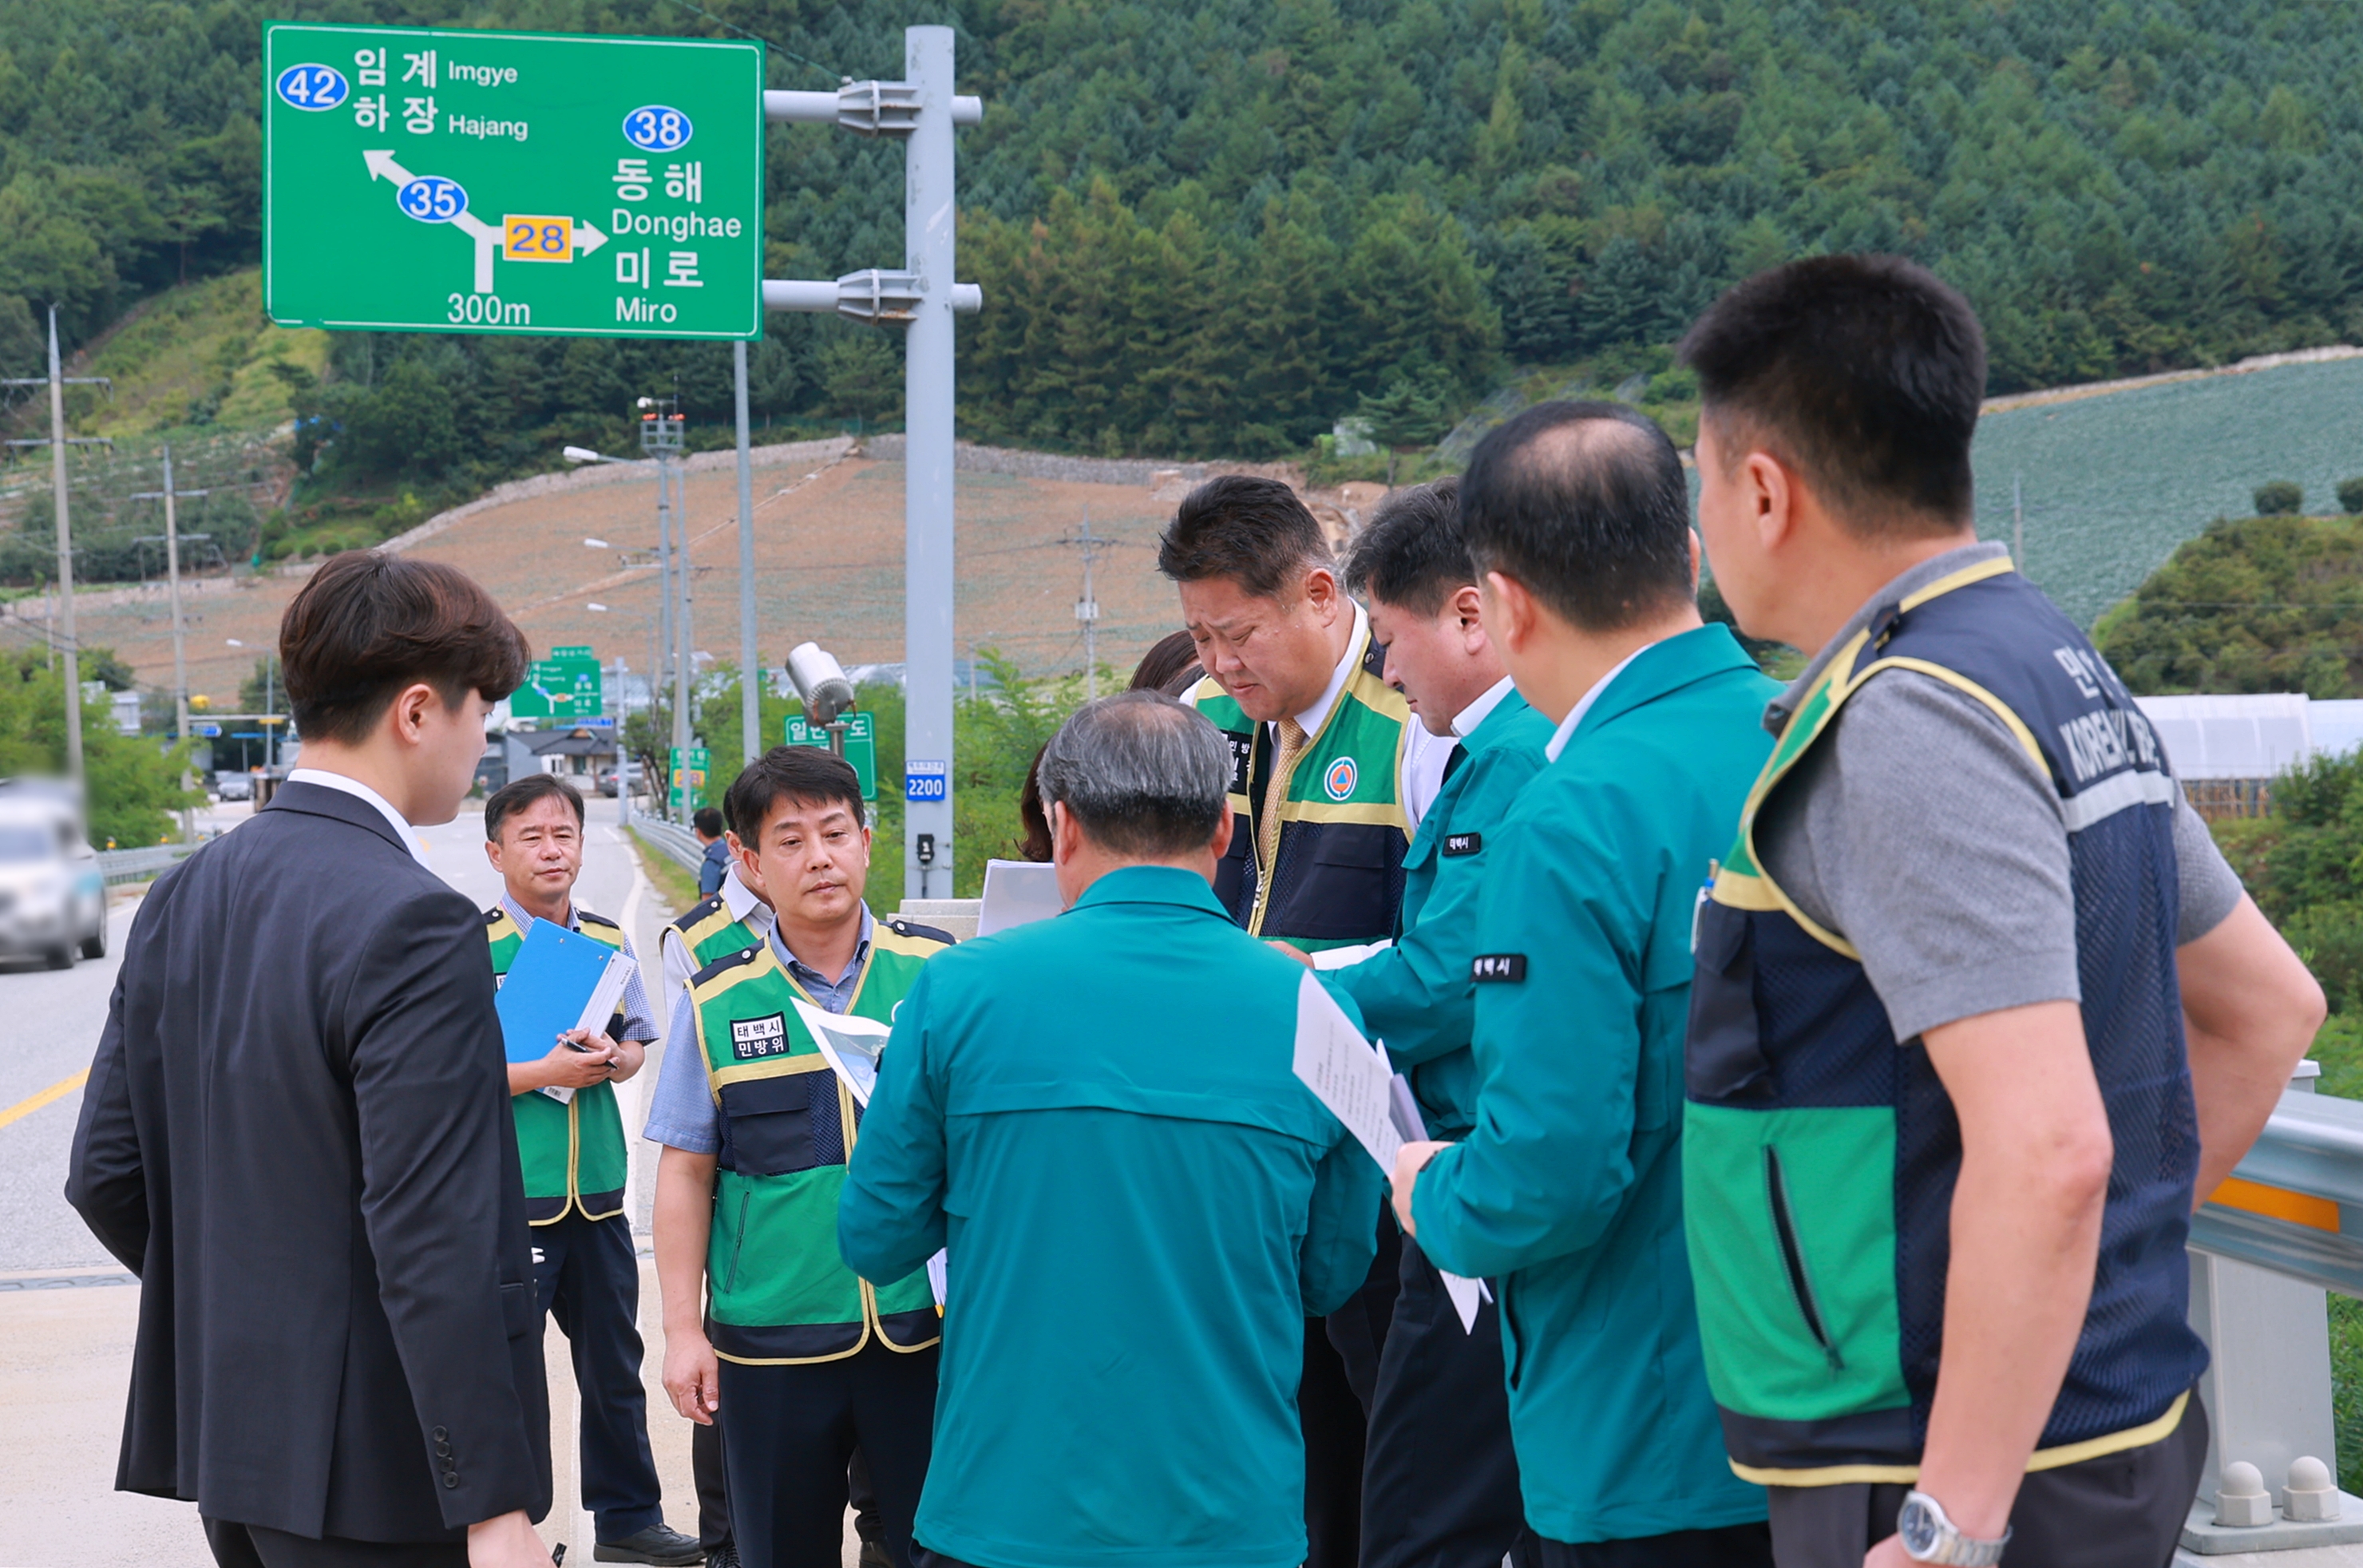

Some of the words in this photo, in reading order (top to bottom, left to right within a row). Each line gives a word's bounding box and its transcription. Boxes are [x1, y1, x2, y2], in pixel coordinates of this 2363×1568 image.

[354, 47, 437, 89] 임계
[449, 61, 518, 87] Imgye
[287, 69, 337, 105] 42
[353, 94, 438, 136] 하장
[449, 116, 529, 142] Hajang
[634, 111, 683, 146] 38
[612, 158, 703, 204] 동해
[410, 182, 458, 217] 35
[511, 224, 565, 254] 28
[612, 208, 742, 244] Donghae
[615, 247, 704, 289] 미로
[447, 293, 531, 326] 300m
[615, 297, 678, 323] Miro
[790, 719, 868, 742] 일반도
[908, 778, 943, 796] 2200
[737, 1020, 780, 1038] 태백시
[738, 1035, 784, 1057] 민방위
